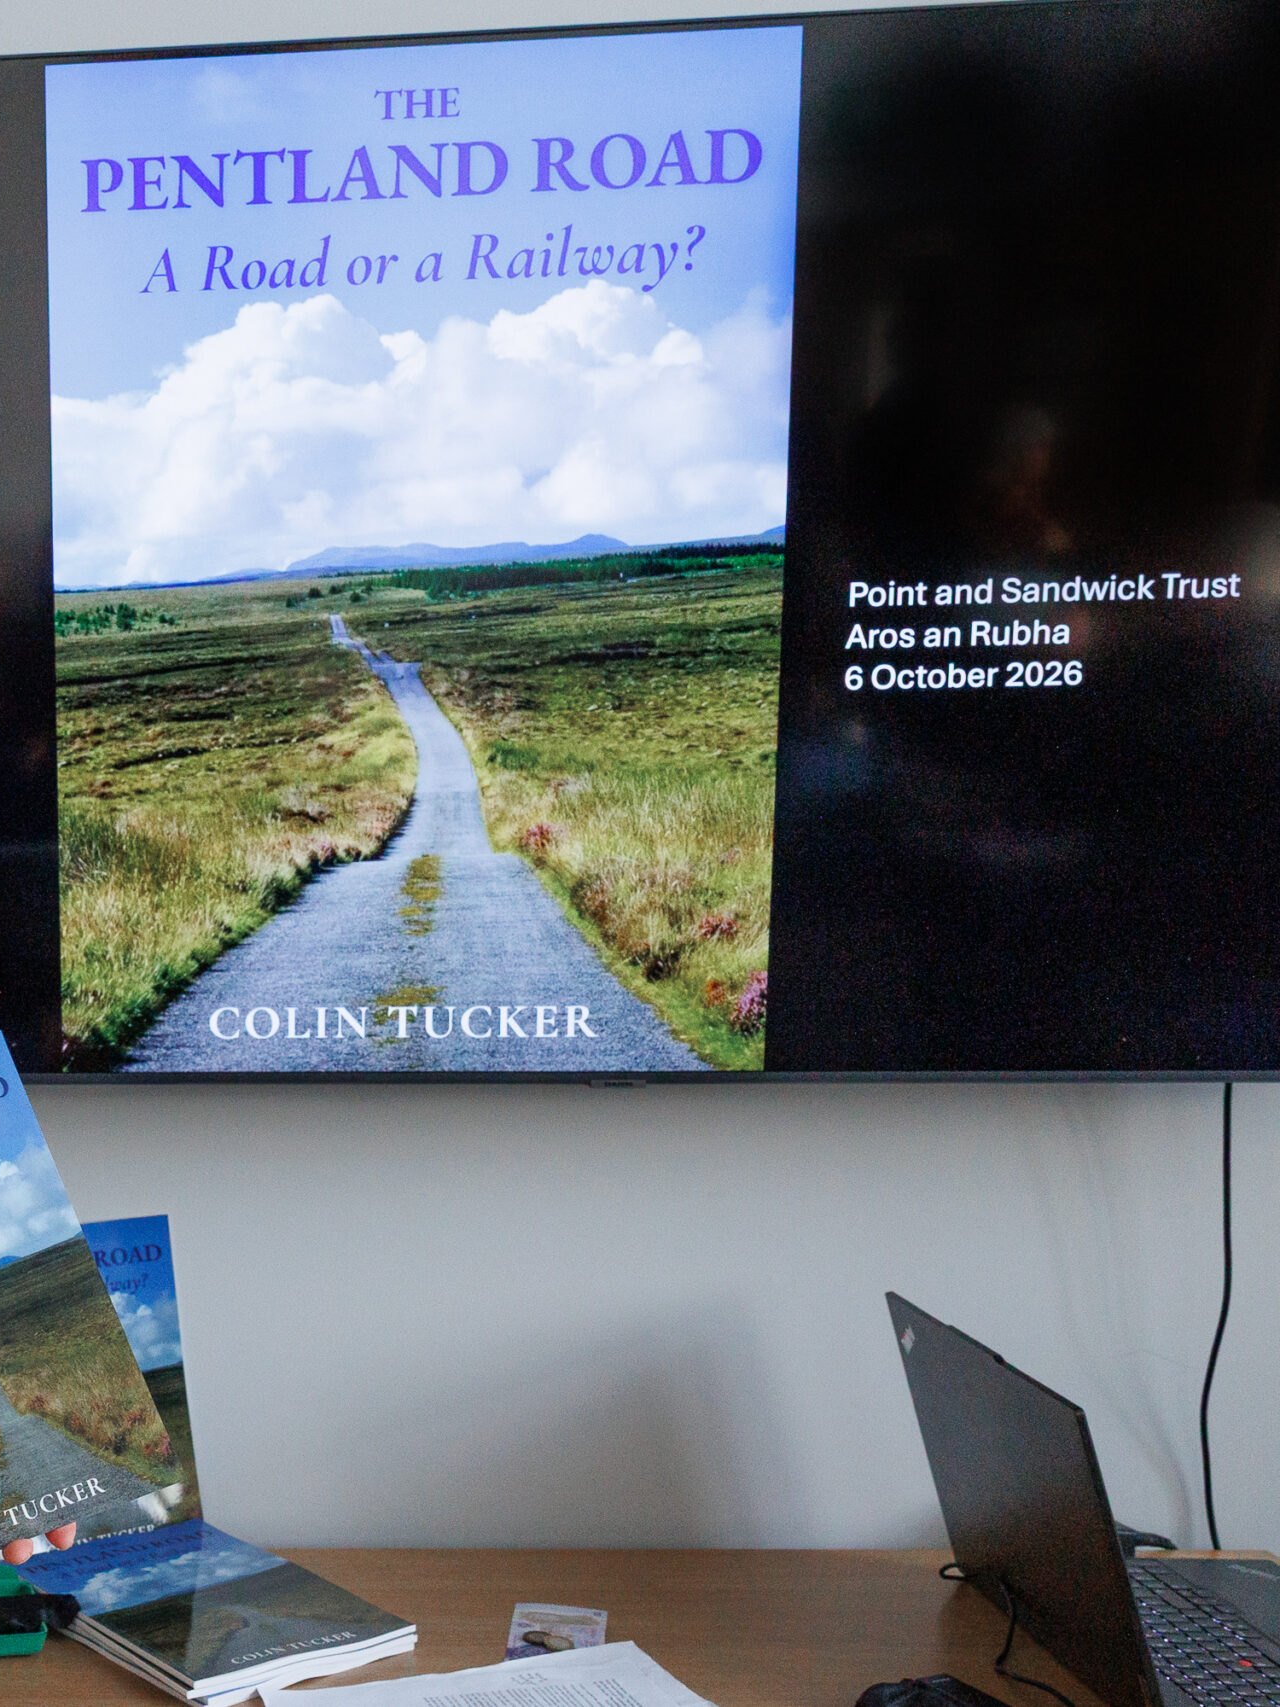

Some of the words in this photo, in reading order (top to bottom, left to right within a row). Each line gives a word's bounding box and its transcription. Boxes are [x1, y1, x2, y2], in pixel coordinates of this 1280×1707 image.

[374, 87, 462, 121] THE
[81, 140, 509, 213] PENTLAND
[531, 128, 763, 192] ROAD
[140, 247, 179, 294] A
[202, 236, 331, 291] Road
[347, 253, 399, 286] or
[415, 251, 443, 282] a
[466, 225, 706, 293] Railway?
[849, 580, 928, 607] Point
[935, 579, 993, 605] and
[1001, 574, 1155, 604] Sandwick
[1162, 573, 1241, 600] Trust
[845, 624, 915, 650] Aros
[923, 627, 961, 647] an
[971, 619, 1070, 647] Rubha
[844, 666, 864, 691] 6
[871, 663, 999, 691] October
[1005, 661, 1083, 688] 2026
[209, 1006, 367, 1040] COLIN
[387, 1005, 599, 1039] TUCKER
[93, 1243, 162, 1268] ROAD
[3, 1477, 106, 1526] TUCKER
[231, 1647, 286, 1665] COLIN
[286, 1630, 357, 1650] TUCKER
